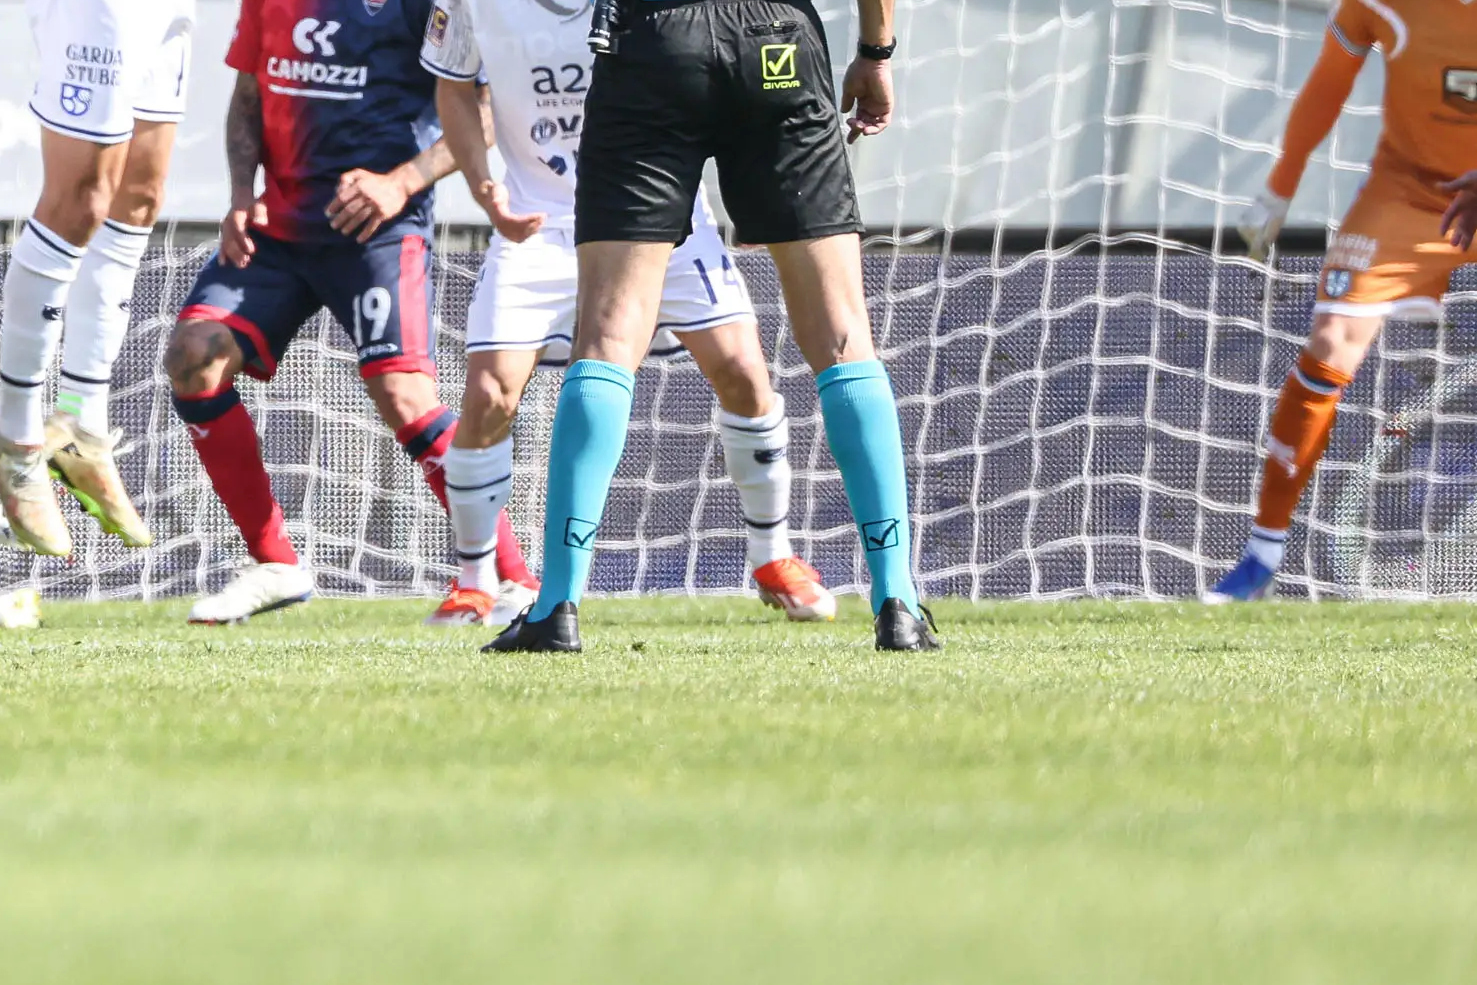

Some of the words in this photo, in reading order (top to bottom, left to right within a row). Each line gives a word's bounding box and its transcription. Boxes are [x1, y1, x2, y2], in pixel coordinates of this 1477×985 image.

[66, 44, 123, 66] GARDA
[65, 63, 121, 87] STUBE
[267, 57, 368, 87] CAMOZZI
[531, 63, 593, 95] a2
[763, 79, 801, 90] GIVOVA
[352, 286, 392, 348] 19
